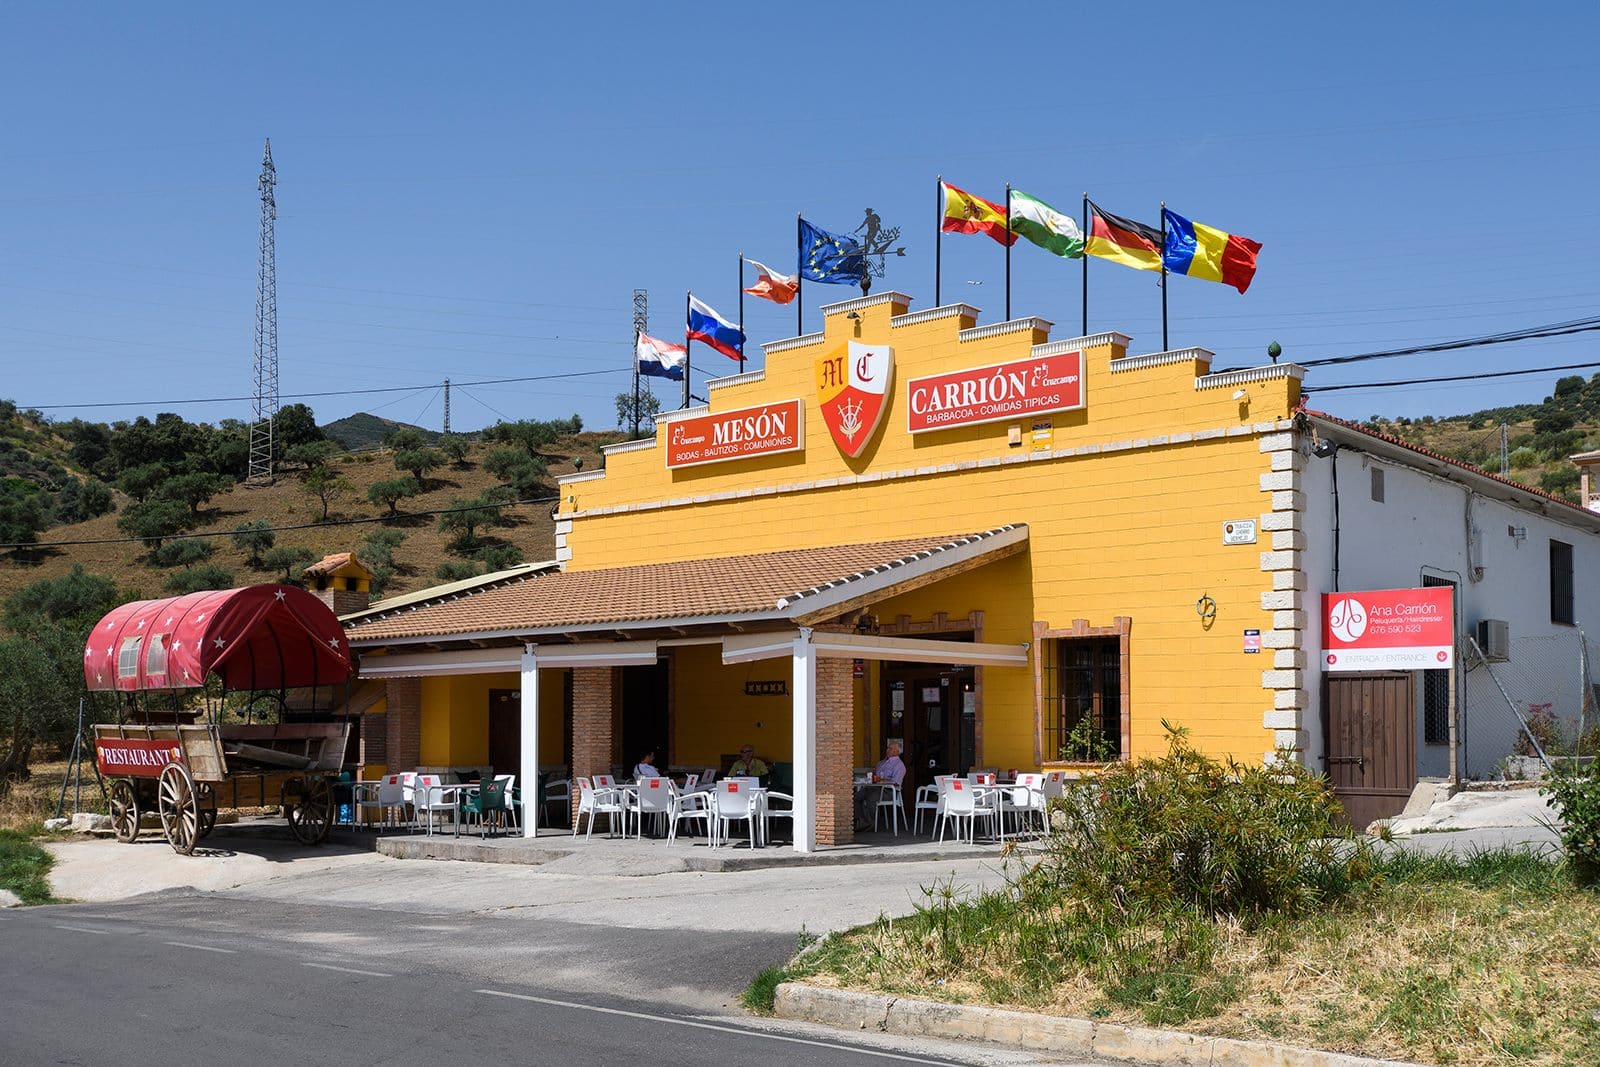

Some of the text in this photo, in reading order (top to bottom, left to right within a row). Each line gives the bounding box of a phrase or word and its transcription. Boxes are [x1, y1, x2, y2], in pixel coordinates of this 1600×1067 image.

[820, 353, 875, 390] M C
[1042, 375, 1079, 387] Cruzcampo
[911, 367, 1029, 415] CARRIÓN
[926, 410, 975, 424] BARBACOA
[980, 400, 1022, 416] COMIDAS
[711, 407, 788, 446] MESÓN
[676, 450, 700, 462] BODAS
[704, 444, 739, 457] BAUTIZOS
[743, 436, 793, 451] COMUNIONES
[1370, 602, 1437, 617] Ana Carrión
[1370, 624, 1422, 635] 676 590 523
[1345, 655, 1380, 664] ENTRADA
[1386, 654, 1428, 663] ENTRANCE
[104, 748, 170, 766] RESTAURANT
